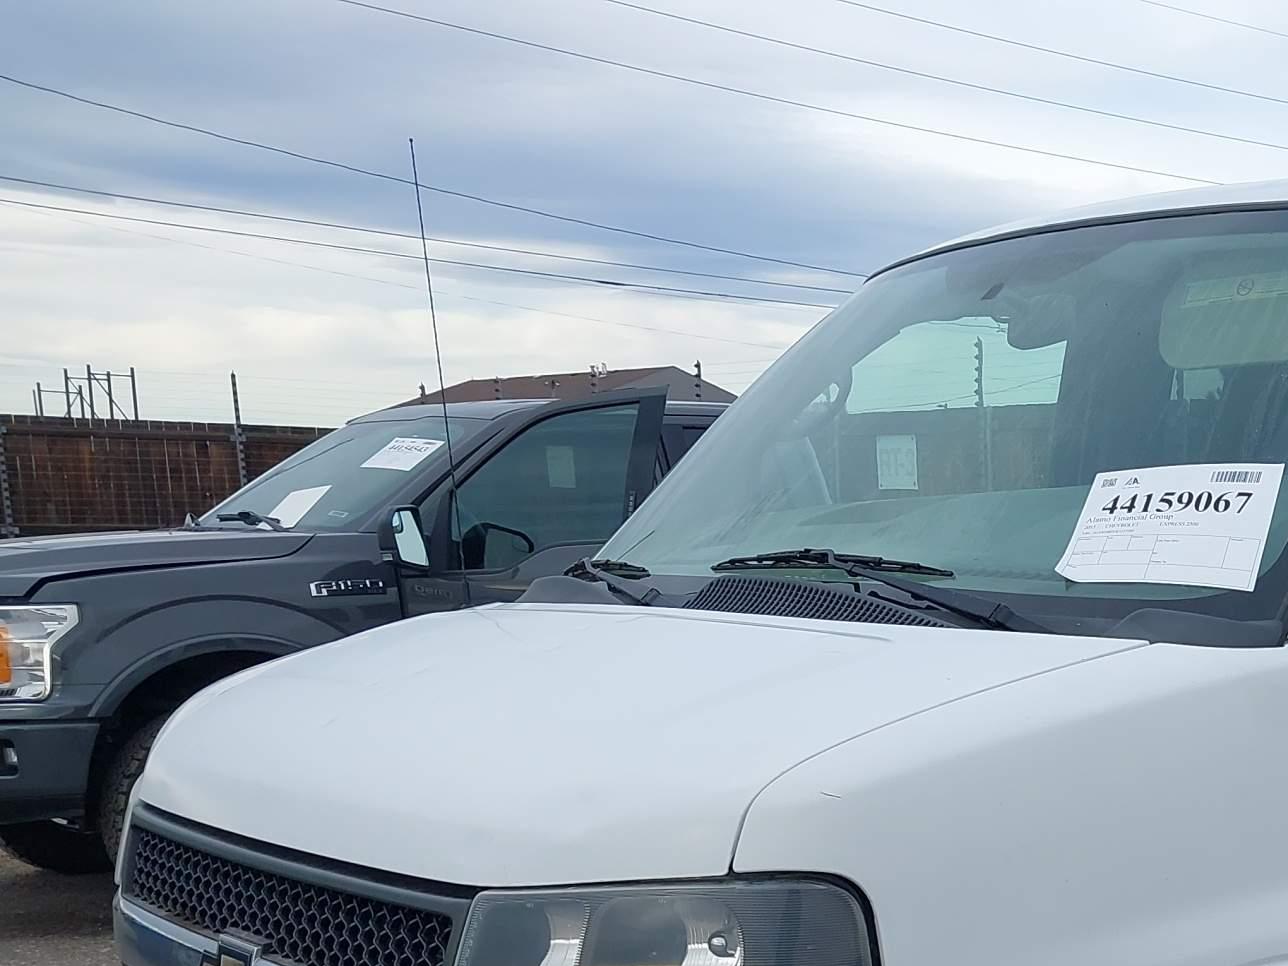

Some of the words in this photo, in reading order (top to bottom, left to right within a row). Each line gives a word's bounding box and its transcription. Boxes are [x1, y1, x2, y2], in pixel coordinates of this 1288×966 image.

[1102, 491, 1254, 514] 44159067
[1113, 513, 1147, 521] Financial
[1149, 513, 1174, 521] Group
